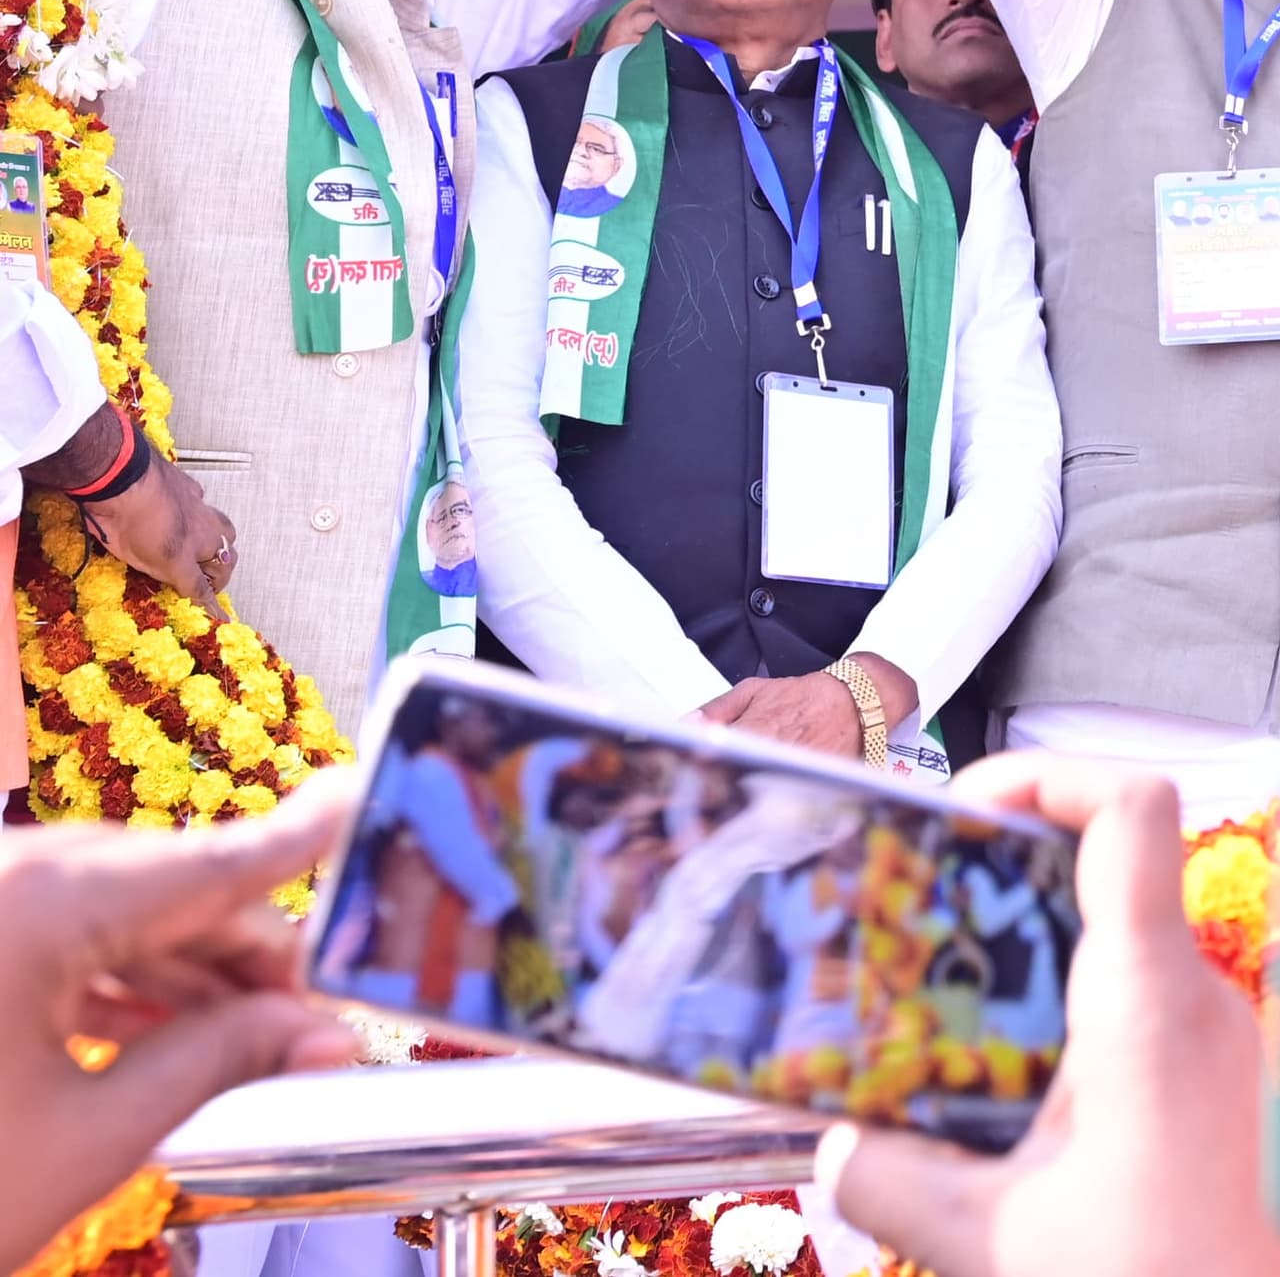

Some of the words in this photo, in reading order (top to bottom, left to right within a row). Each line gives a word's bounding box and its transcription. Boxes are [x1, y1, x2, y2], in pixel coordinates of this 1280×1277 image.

[553, 276, 577, 294] तीर
[557, 328, 585, 352] दल
[585, 333, 617, 365] (यू)
